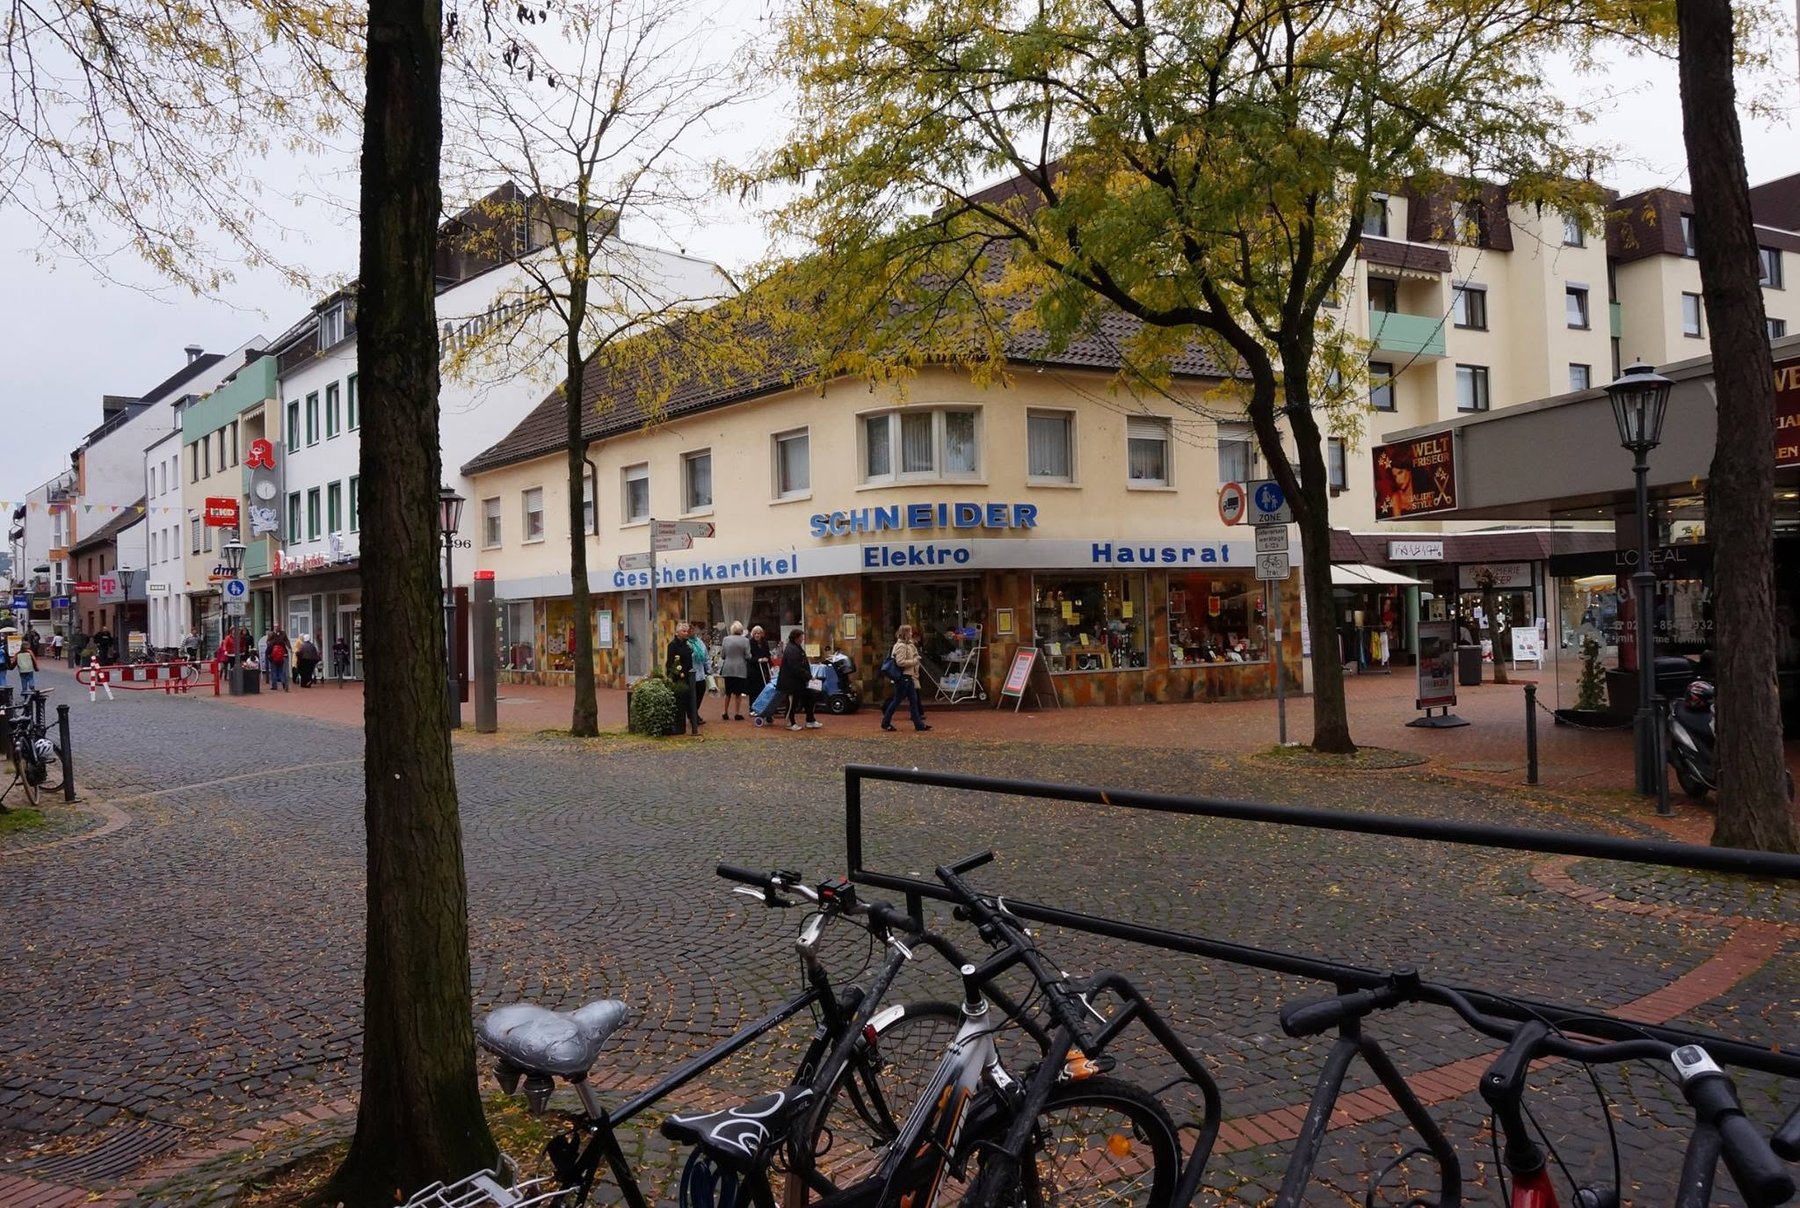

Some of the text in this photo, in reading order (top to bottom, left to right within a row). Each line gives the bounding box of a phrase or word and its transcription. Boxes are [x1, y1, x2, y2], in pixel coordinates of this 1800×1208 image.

[1411, 437, 1449, 457] WELT
[1412, 453, 1450, 468] FRISEUR
[809, 502, 1038, 538] SCHNEIDER
[1259, 513, 1282, 522] ZONE
[864, 544, 970, 568] Elektro
[1092, 543, 1229, 563] Hausrat
